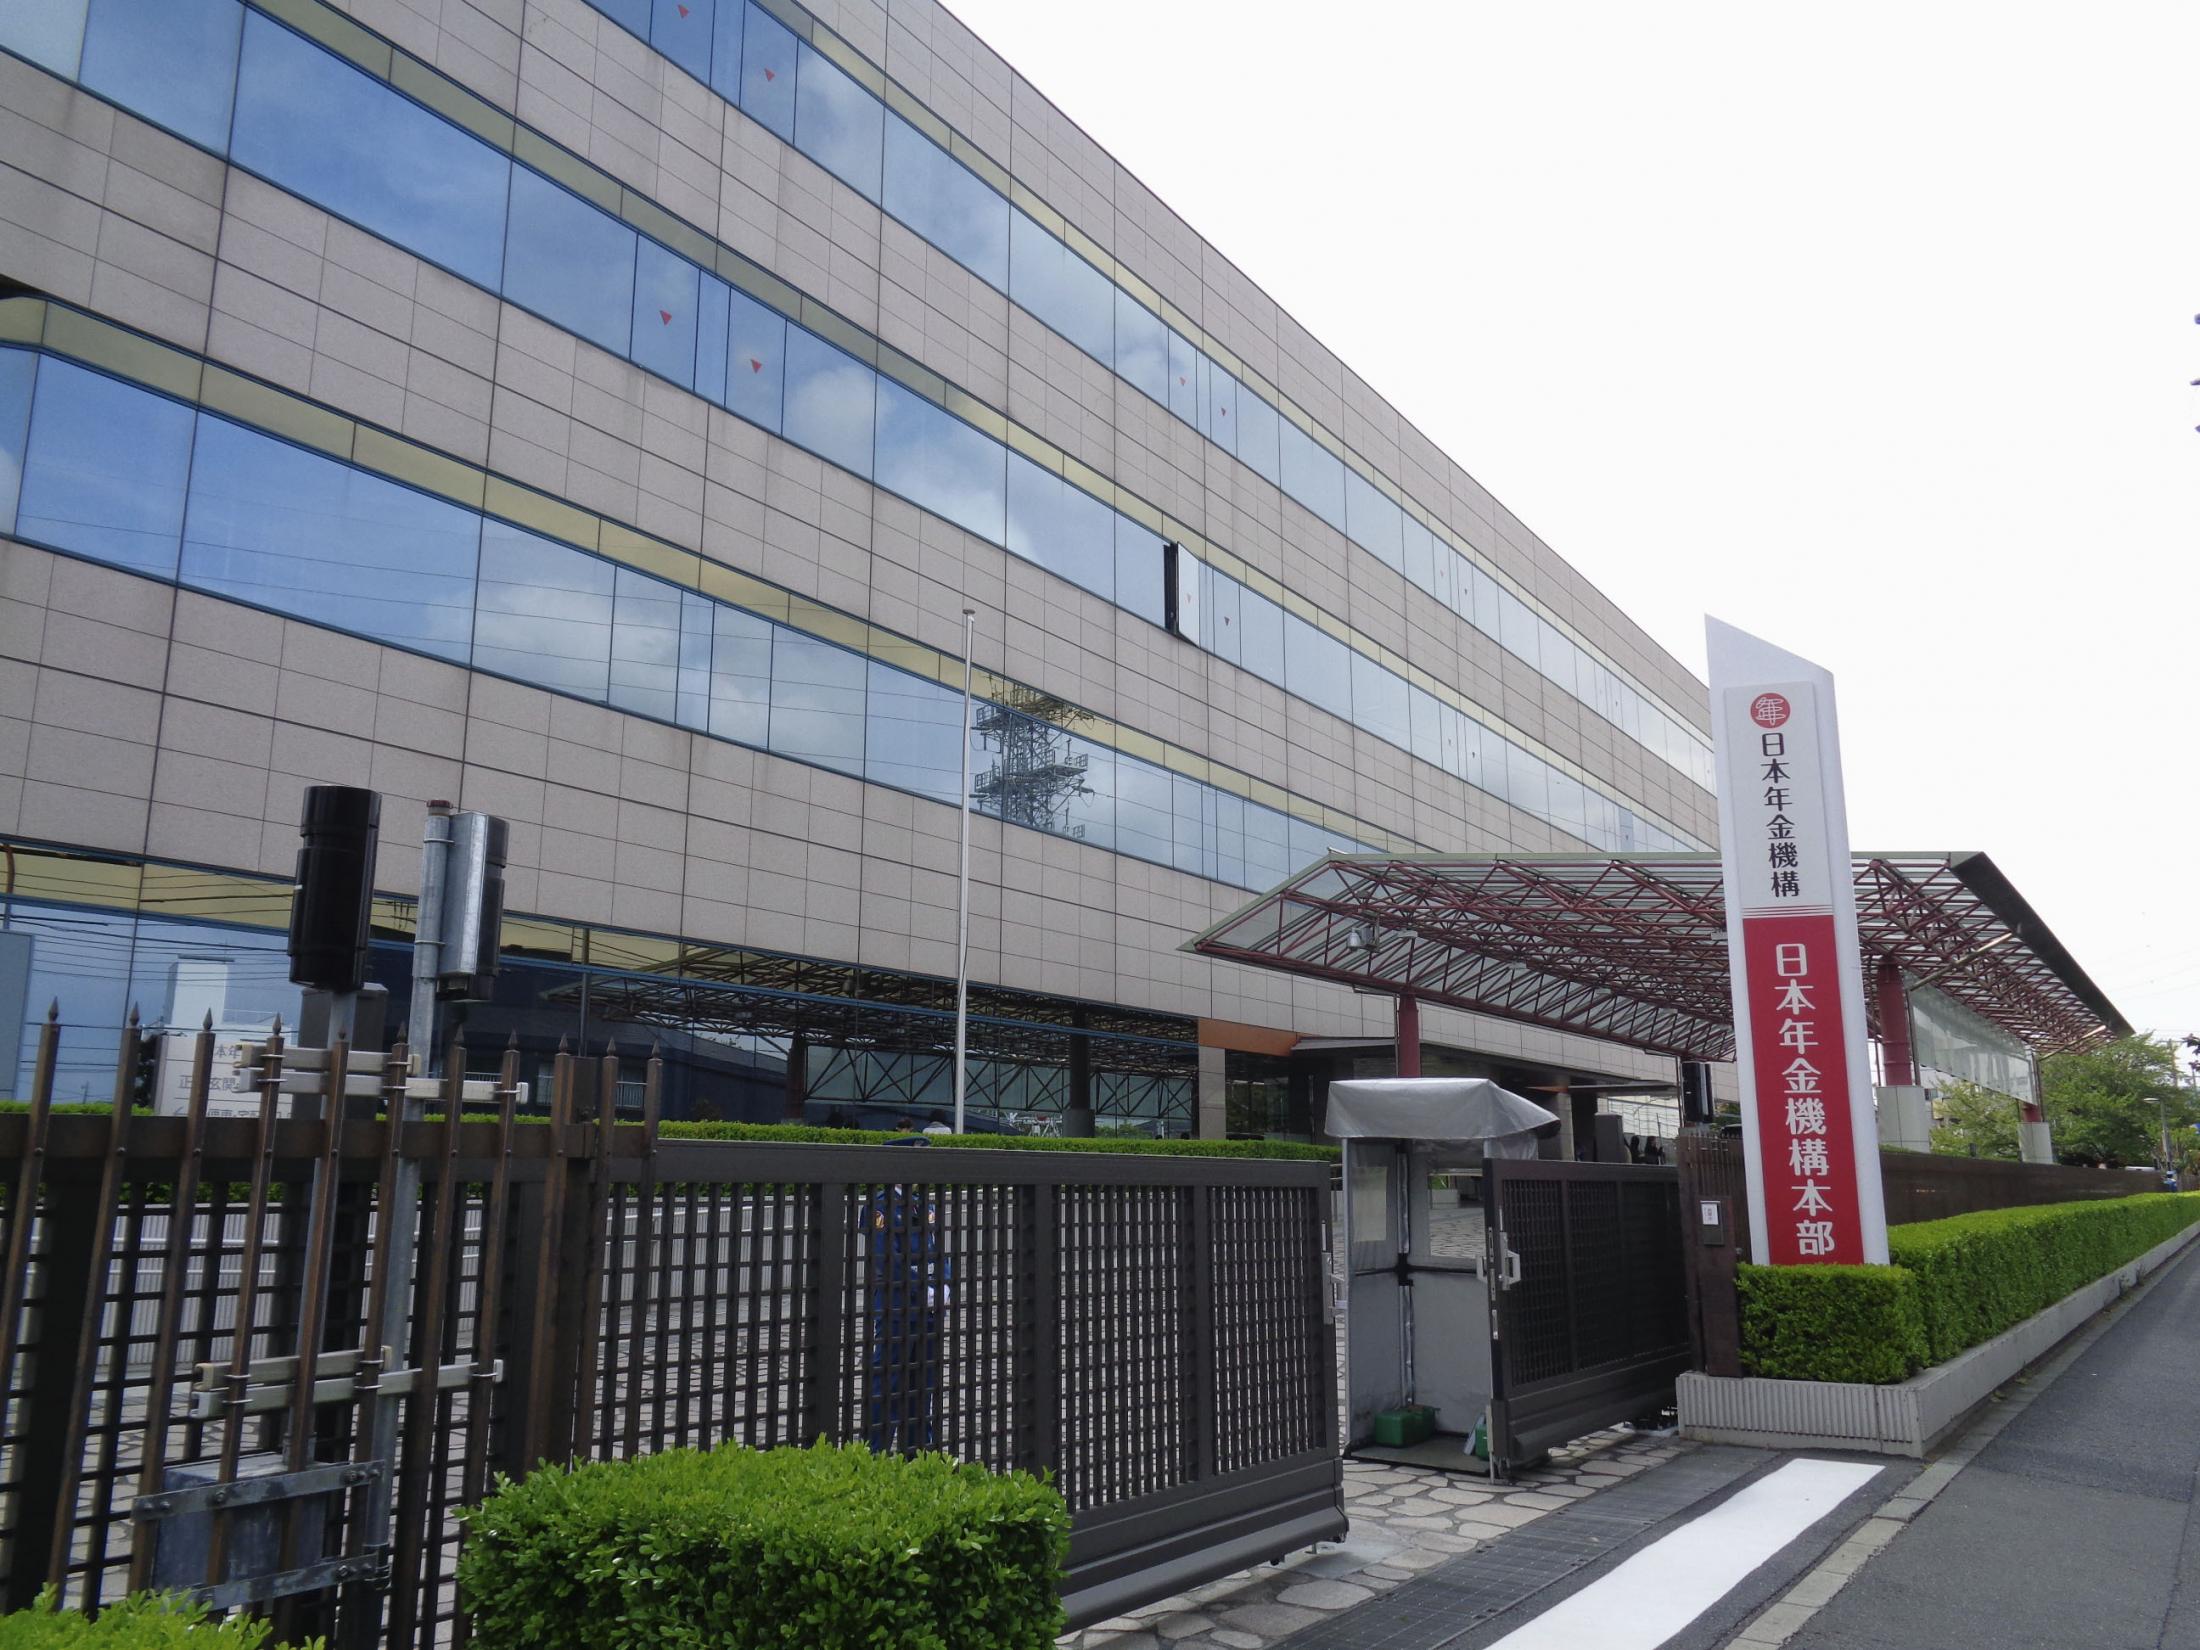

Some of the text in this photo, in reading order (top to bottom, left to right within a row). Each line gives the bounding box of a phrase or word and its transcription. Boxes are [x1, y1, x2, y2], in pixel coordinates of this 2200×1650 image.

[1761, 733, 1800, 897] 日本年金機構
[1774, 943, 1836, 1256] 日本年金機構本部
